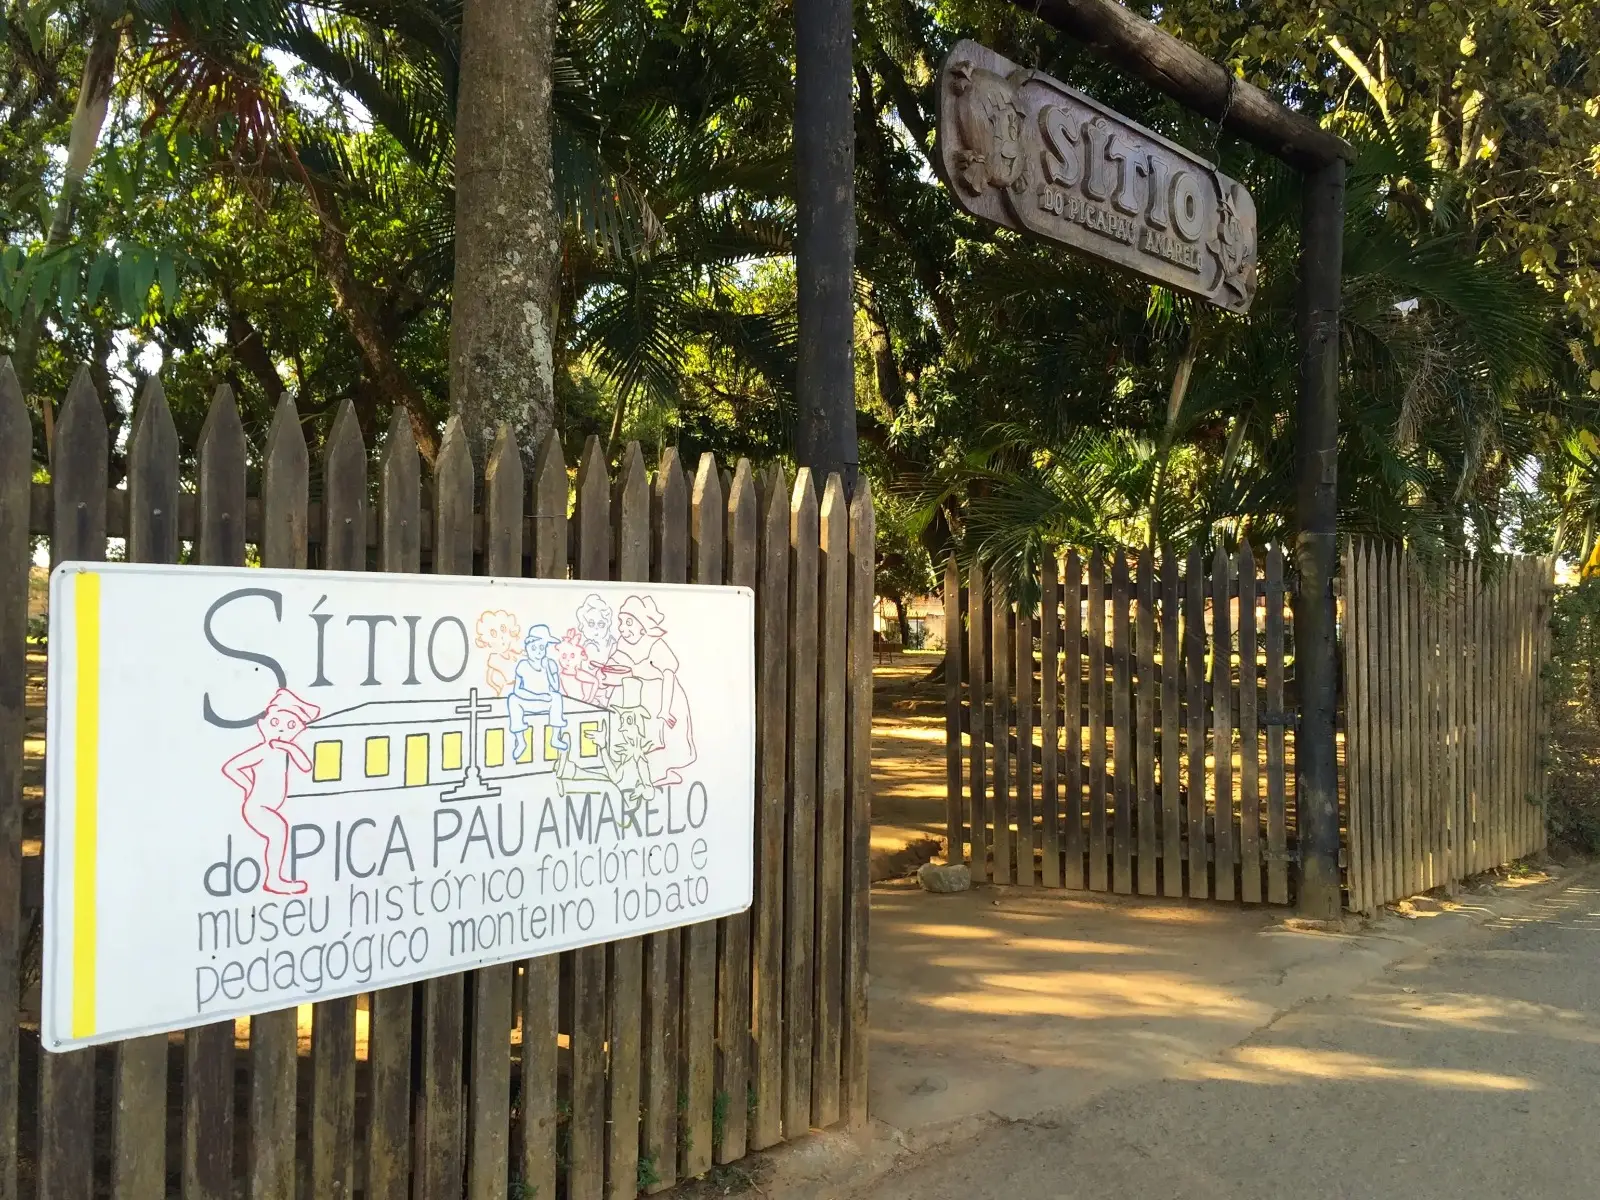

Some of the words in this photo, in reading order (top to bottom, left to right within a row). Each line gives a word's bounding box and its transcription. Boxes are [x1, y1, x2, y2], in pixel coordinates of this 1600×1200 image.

[1043, 184, 1064, 216] DO
[1067, 197, 1137, 246] PICAPAU
[203, 587, 469, 729] SÍTIO
[197, 895, 330, 951] museu
[349, 866, 524, 928] histórico
[537, 843, 679, 896] folclórico
[690, 837, 708, 870] e
[203, 833, 261, 897] do
[290, 814, 416, 882] PICA
[433, 799, 524, 868] PAU
[534, 780, 708, 853] AMARELO
[195, 925, 429, 1013] pedagógico
[448, 897, 595, 957] monteiro
[613, 873, 710, 924] lobato
